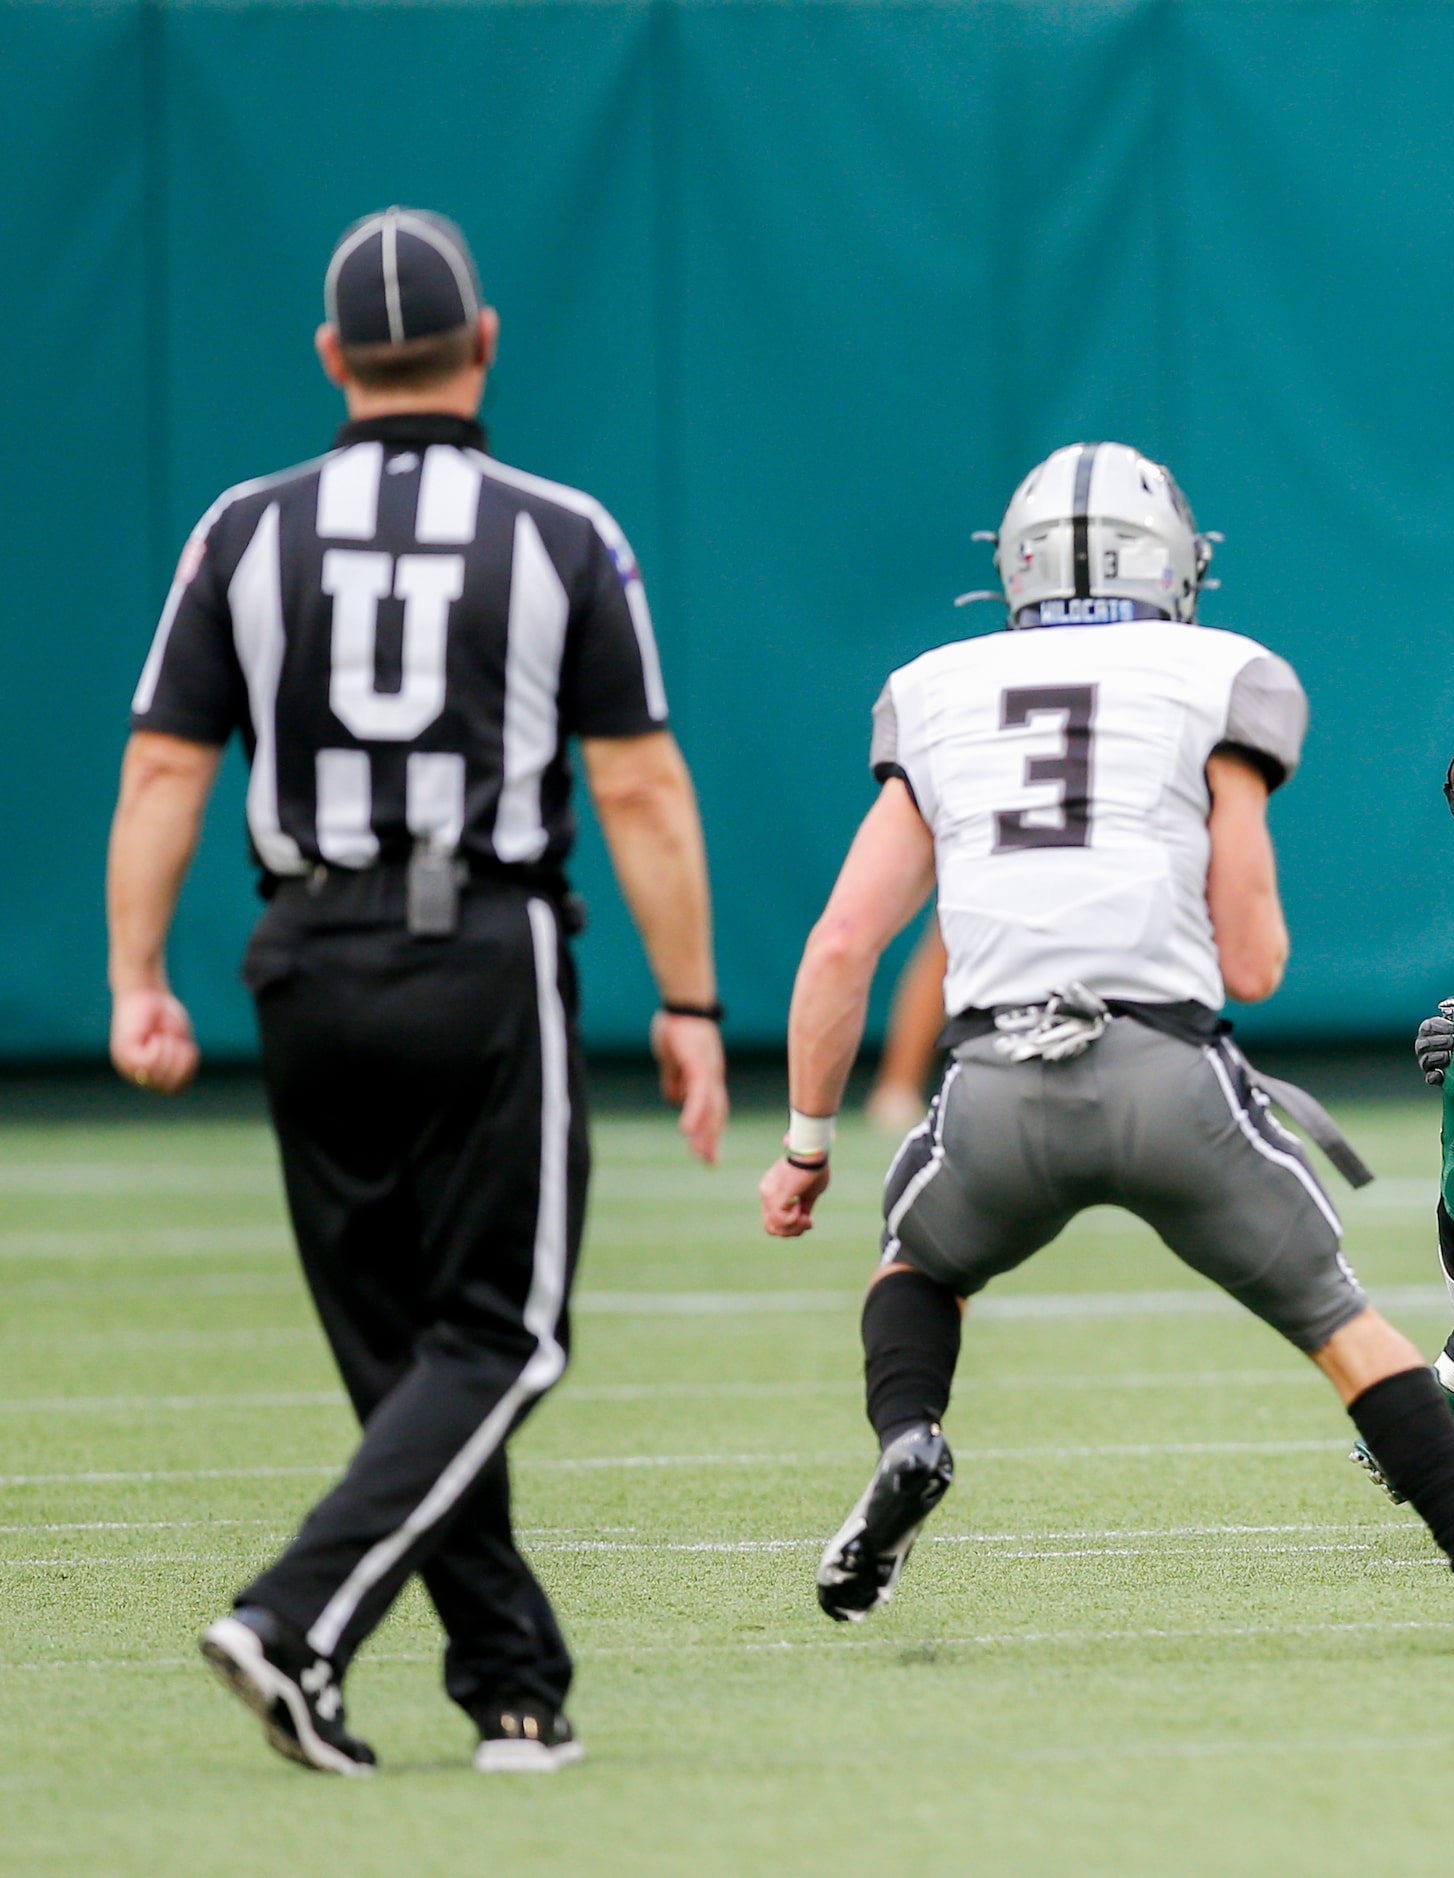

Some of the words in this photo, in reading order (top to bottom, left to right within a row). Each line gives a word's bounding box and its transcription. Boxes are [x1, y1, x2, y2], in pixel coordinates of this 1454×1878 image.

[321, 548, 465, 742] U
[1104, 551, 1118, 578] 3
[991, 682, 1099, 854] 3
